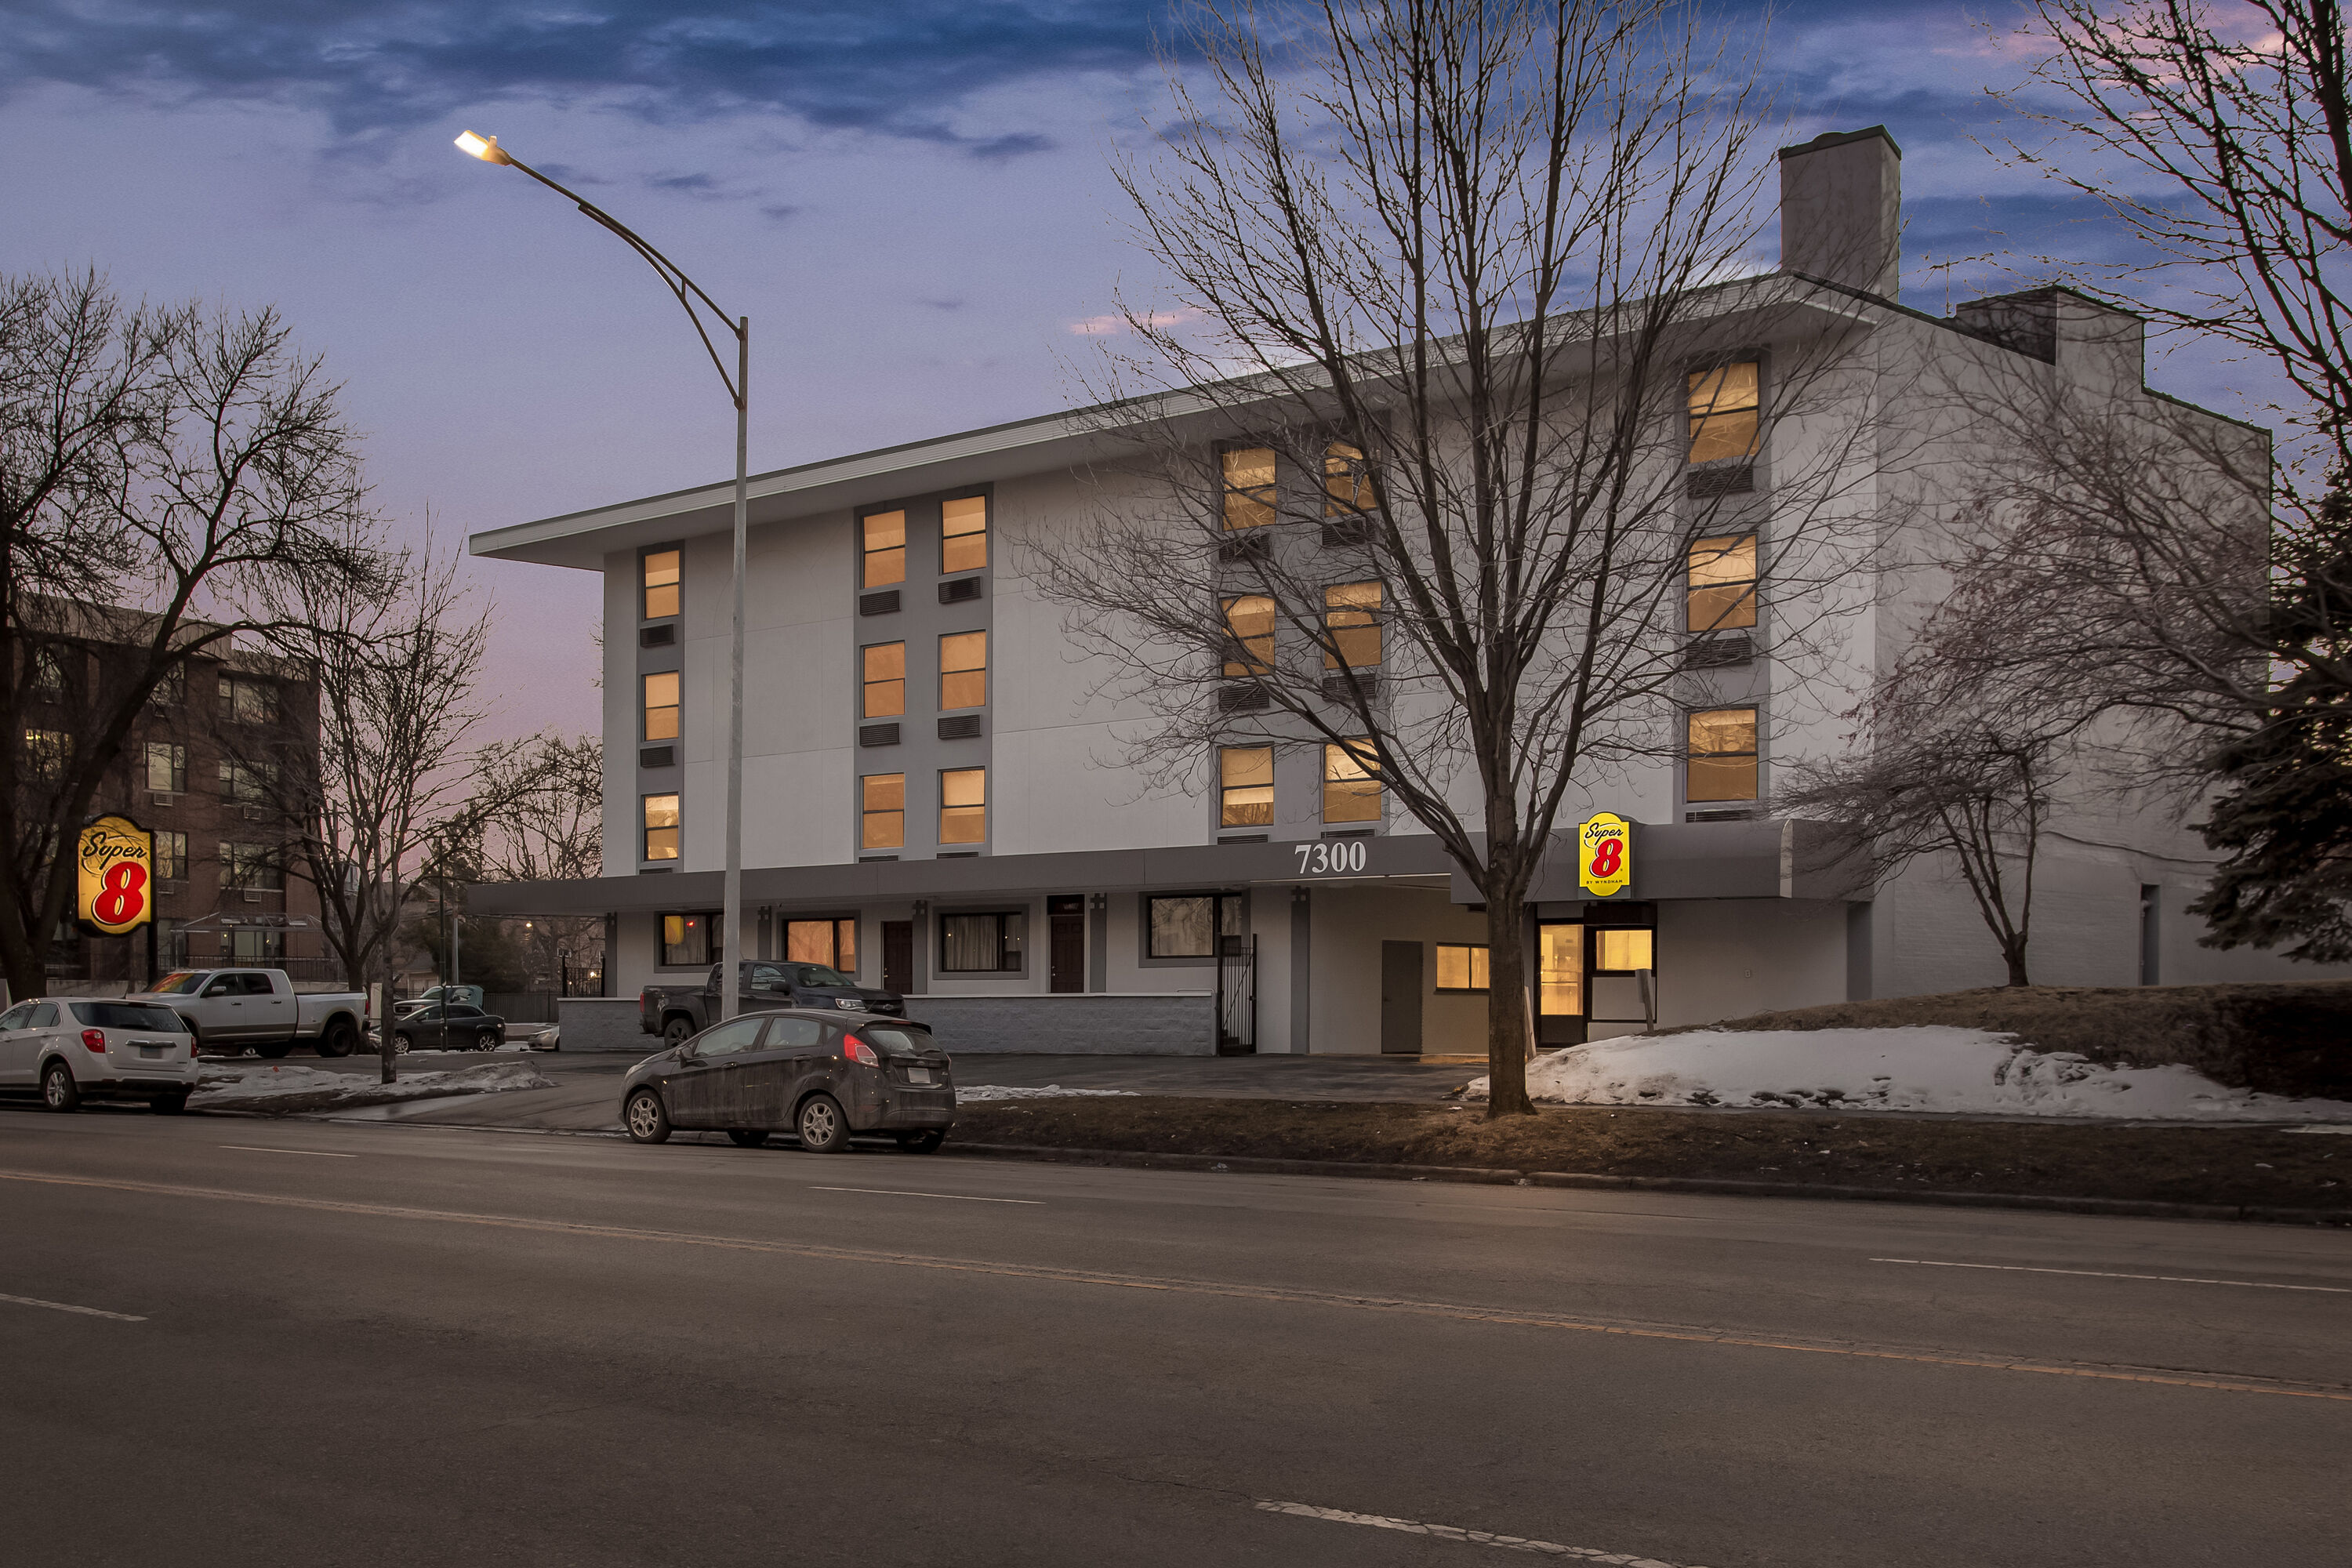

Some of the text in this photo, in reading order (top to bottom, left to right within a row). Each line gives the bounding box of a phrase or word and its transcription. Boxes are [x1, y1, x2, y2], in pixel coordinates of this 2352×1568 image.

[82, 832, 147, 870] Super
[1584, 822, 1624, 846] Super
[1294, 841, 1367, 874] 7300
[1589, 838, 1624, 878] 8
[91, 861, 147, 926] 8
